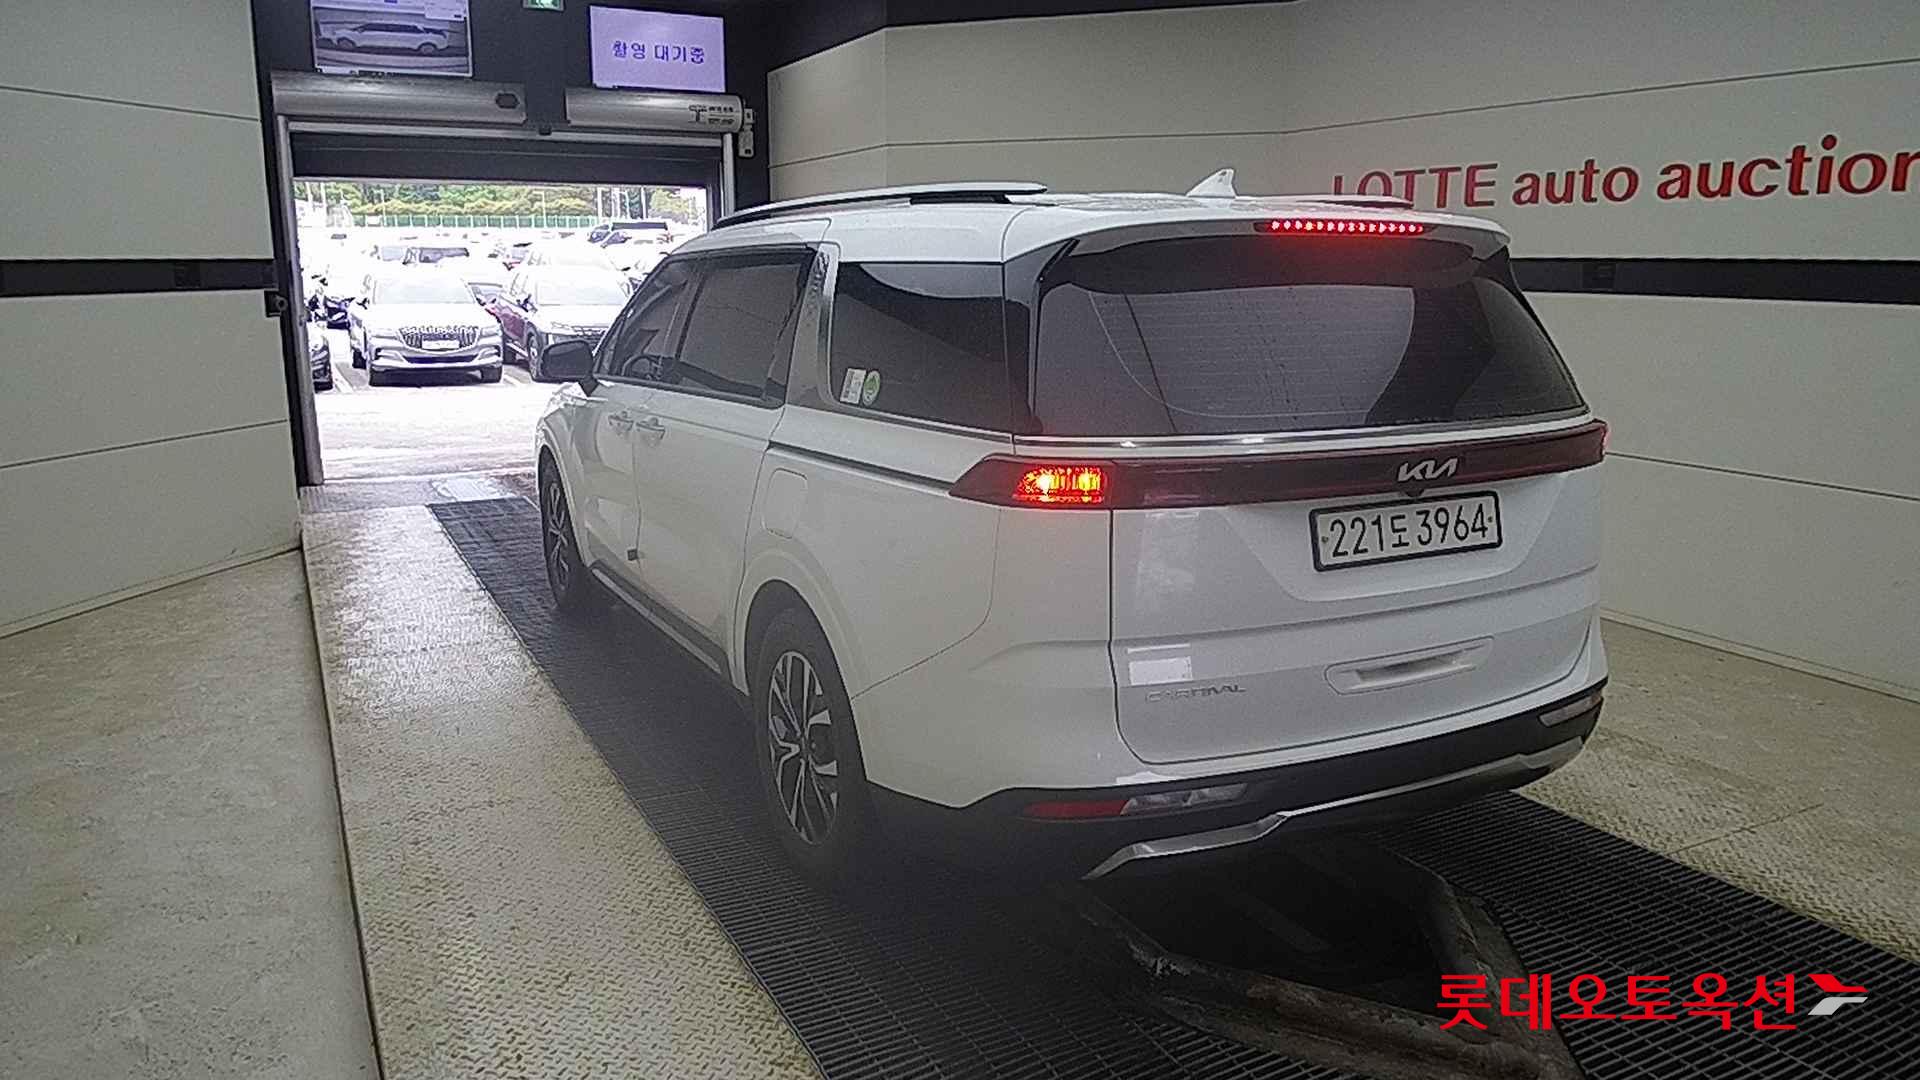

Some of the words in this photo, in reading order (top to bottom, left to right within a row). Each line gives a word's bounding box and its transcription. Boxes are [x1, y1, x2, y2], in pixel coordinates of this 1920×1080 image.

[613, 40, 646, 60] 촬영
[654, 44, 705, 65] 대기중
[1512, 158, 1639, 206] auto
[1397, 458, 1459, 482] KIA
[1329, 503, 1489, 558] 221도3964
